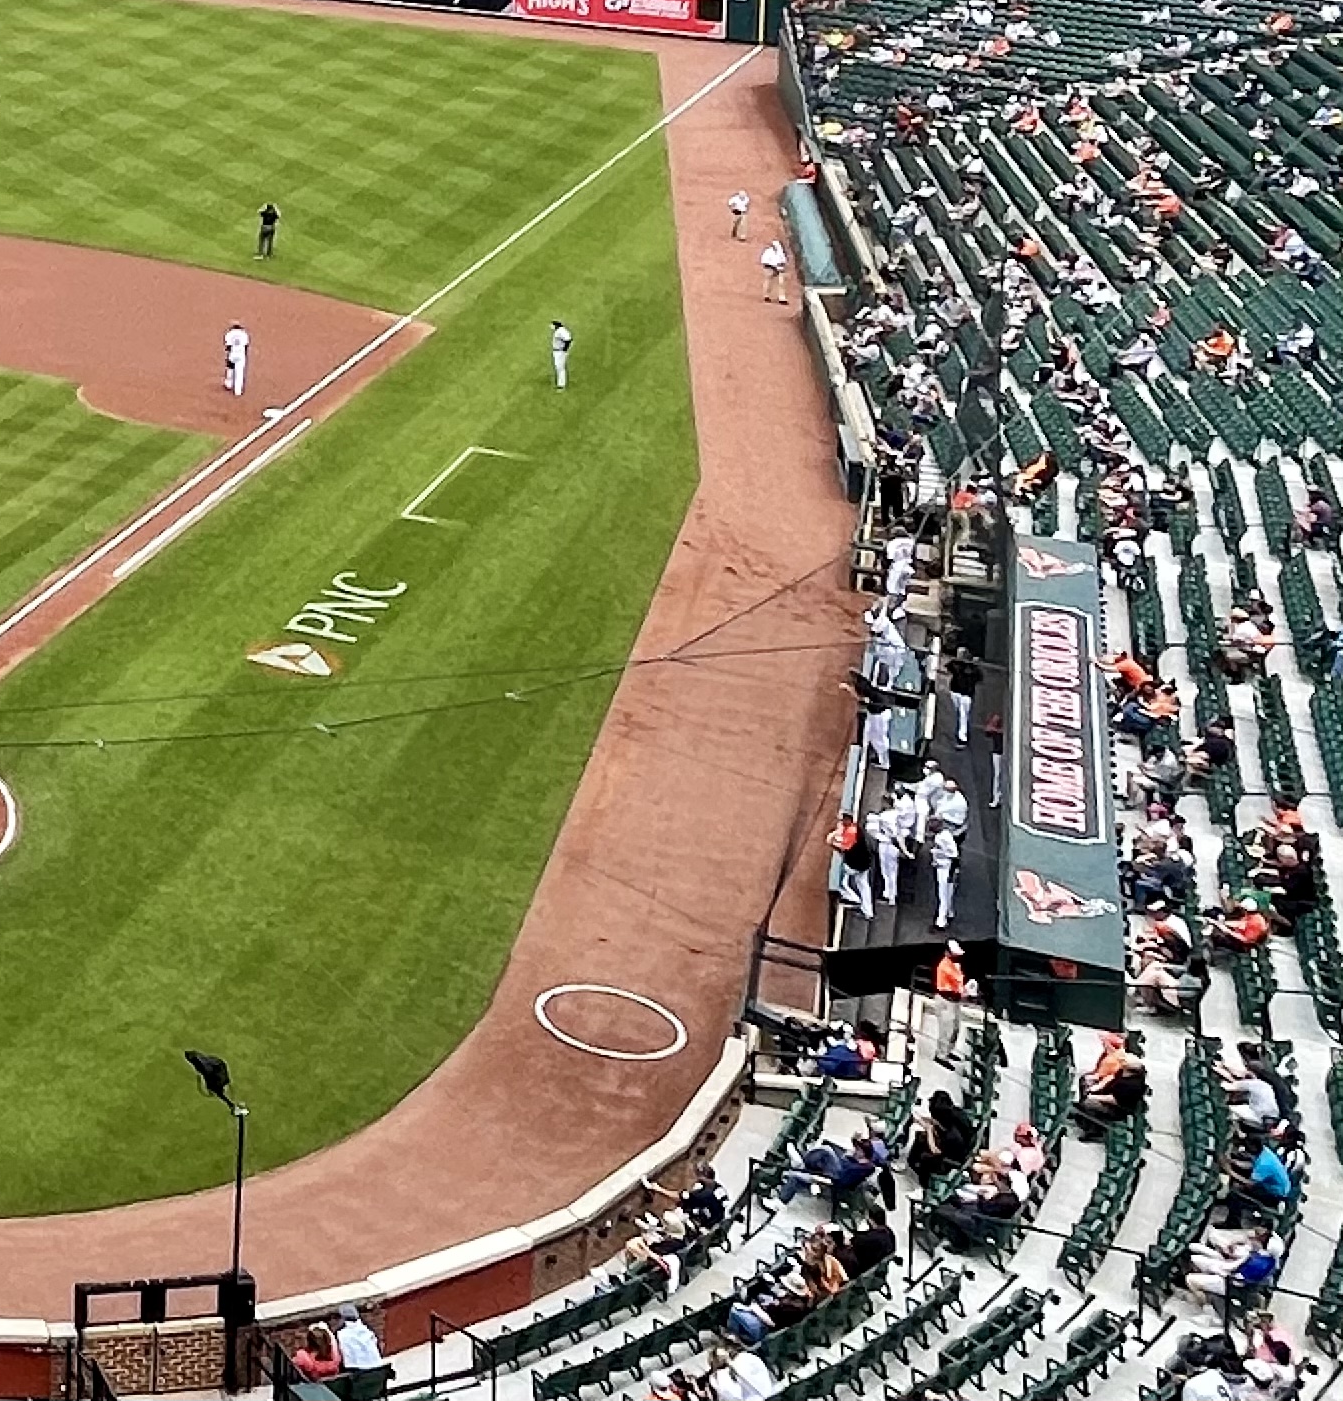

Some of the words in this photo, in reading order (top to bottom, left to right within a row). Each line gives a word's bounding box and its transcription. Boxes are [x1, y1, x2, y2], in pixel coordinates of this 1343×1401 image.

[282, 570, 408, 643] PNC
[1029, 610, 1081, 687] ORIOLES
[1030, 685, 1083, 730] THE
[1030, 726, 1084, 760] OF
